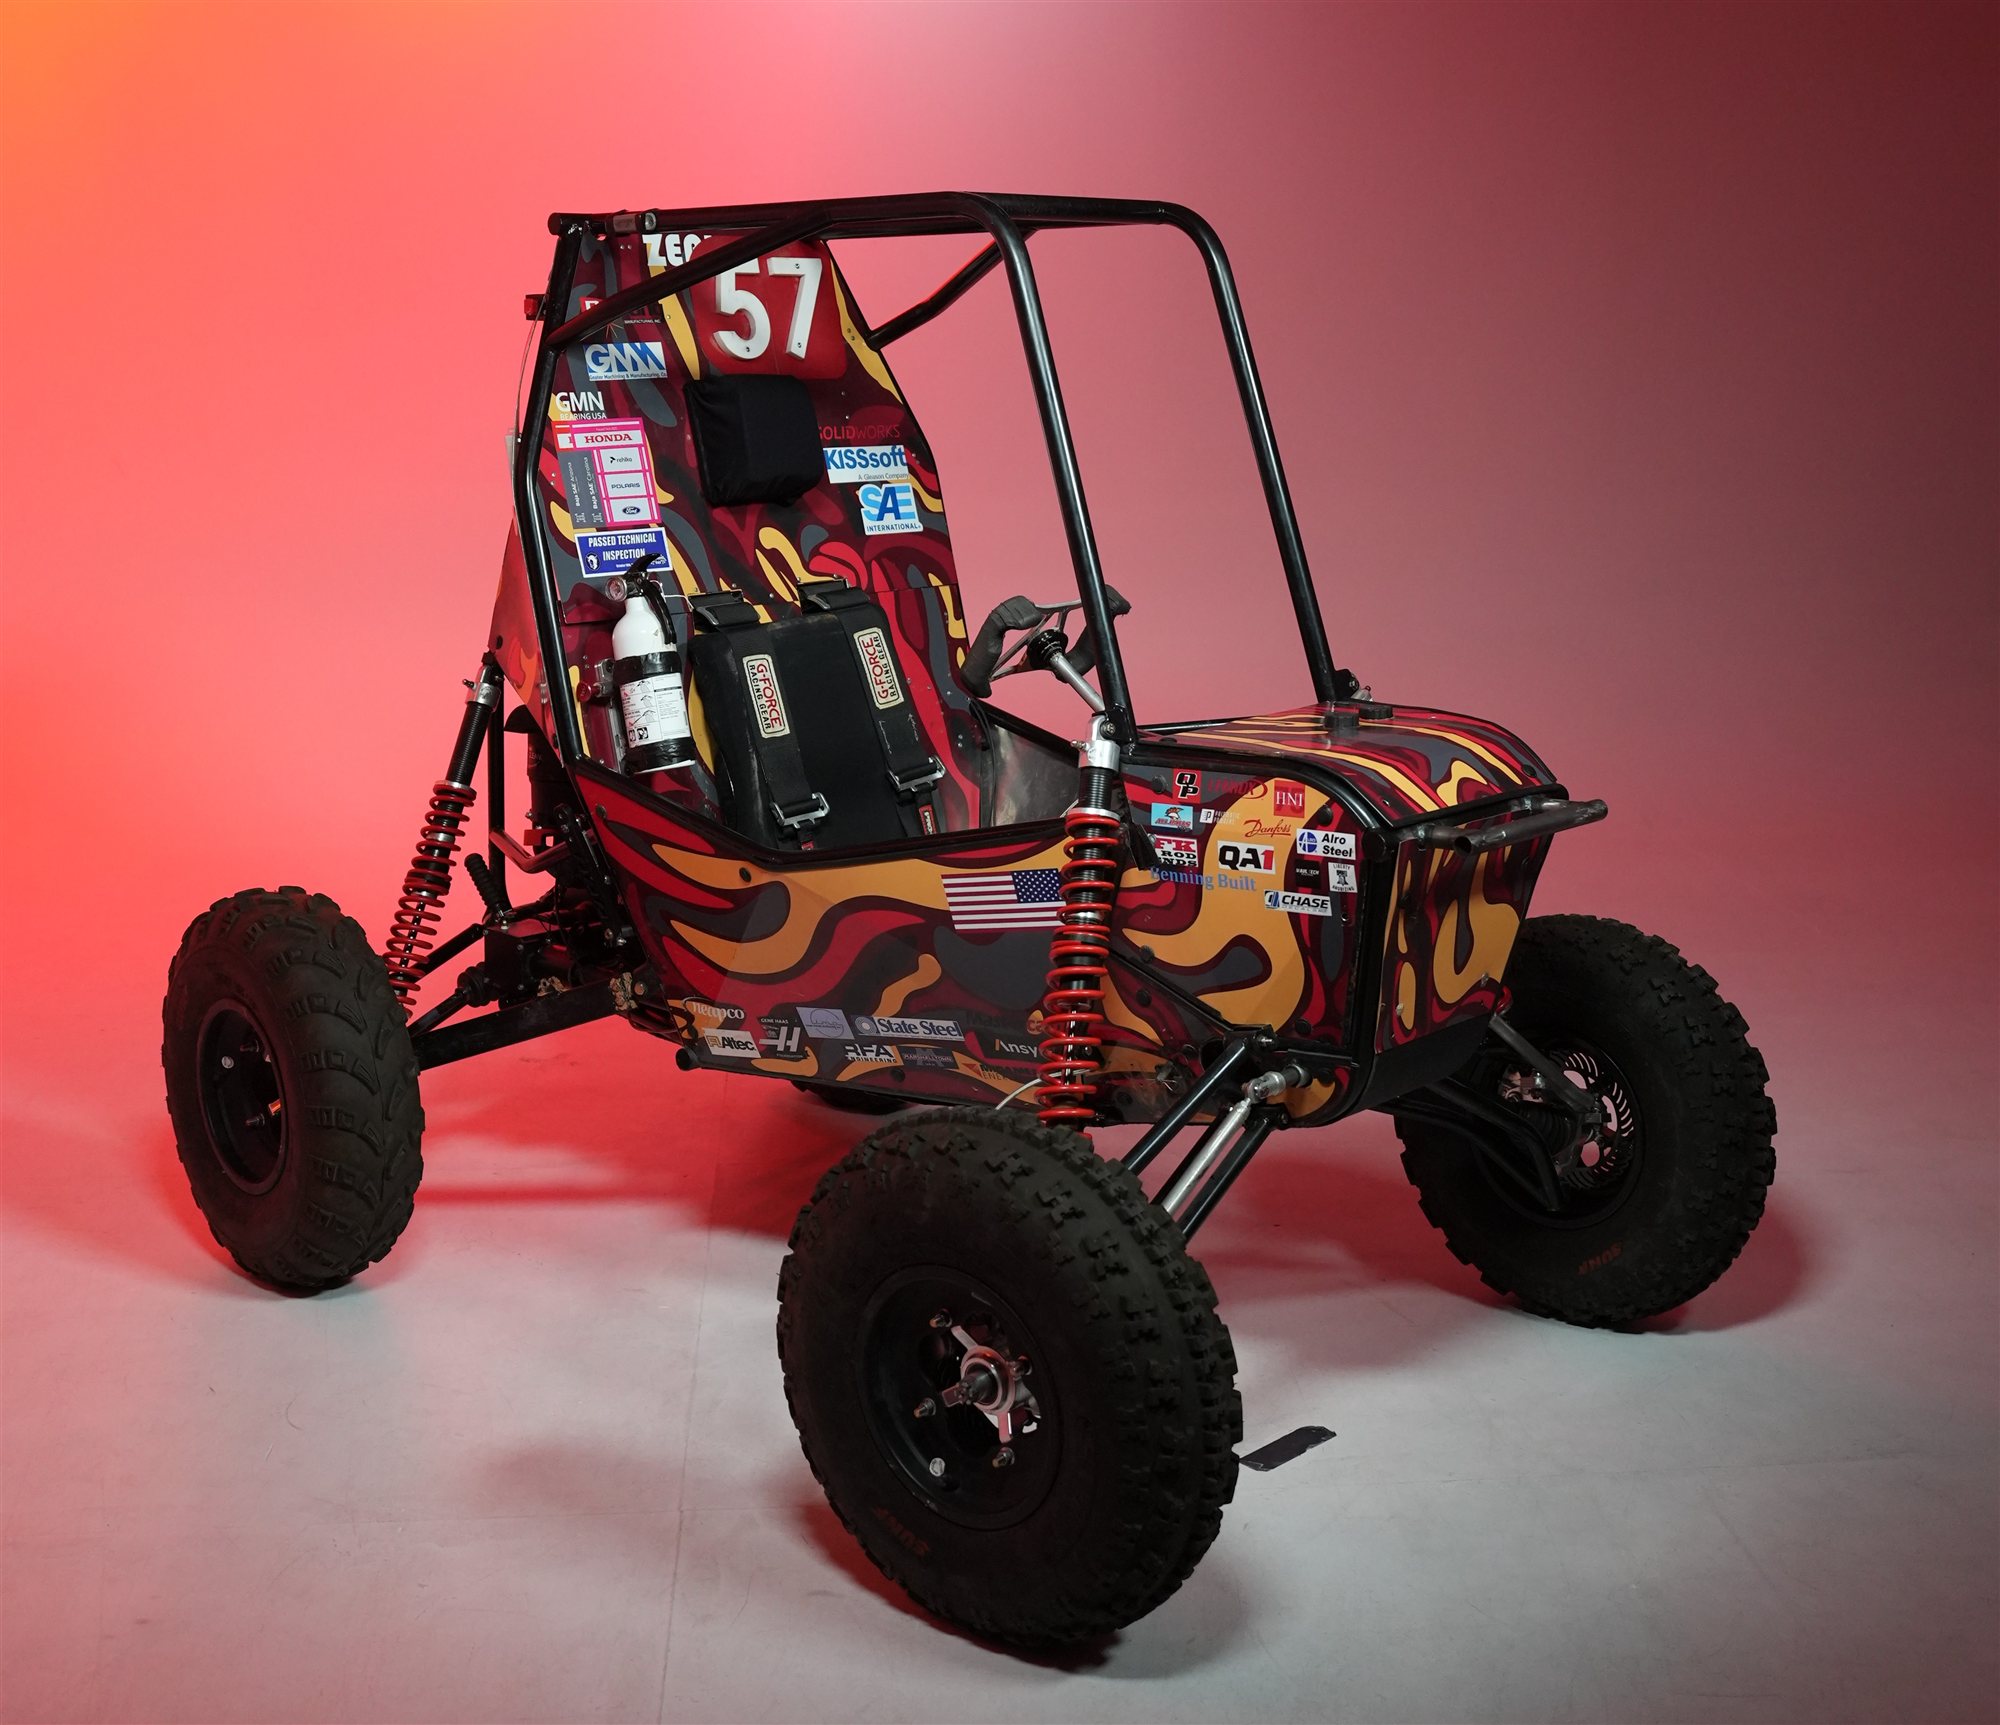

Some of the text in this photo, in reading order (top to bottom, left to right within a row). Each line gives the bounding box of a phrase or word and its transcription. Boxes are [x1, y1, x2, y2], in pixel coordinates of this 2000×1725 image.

[712, 257, 823, 360] 57
[555, 391, 605, 412] GMN
[560, 412, 607, 421] BEARING USA
[584, 433, 633, 444] HONDA
[823, 445, 908, 470] KISSsoft
[885, 472, 909, 481] Company
[860, 485, 916, 521] SAE
[866, 523, 919, 533] INTERNATIONAL
[588, 532, 657, 547] PASSED TECHNICAL
[602, 548, 646, 561] INSPECTION
[862, 637, 889, 699] G-FORCE
[872, 635, 897, 698] RACING GEAR
[749, 664, 772, 730] RACING GEAR
[756, 663, 783, 729] G-FORCE
[1275, 791, 1303, 807] HNI
[1243, 819, 1292, 838] Danfoss
[1154, 838, 1196, 853] FK
[1321, 833, 1347, 845] Alro
[1160, 850, 1197, 860] ROD
[1218, 844, 1275, 871] QA1
[1322, 844, 1353, 858] Steel
[1158, 857, 1198, 867] NDS
[1150, 866, 1257, 892] Benning Built
[1281, 894, 1330, 909] CHASE
[877, 1018, 920, 1035] State
[924, 1020, 963, 1037] Steel
[844, 1044, 893, 1058] RFA
[995, 1039, 1038, 1058] Ansy
